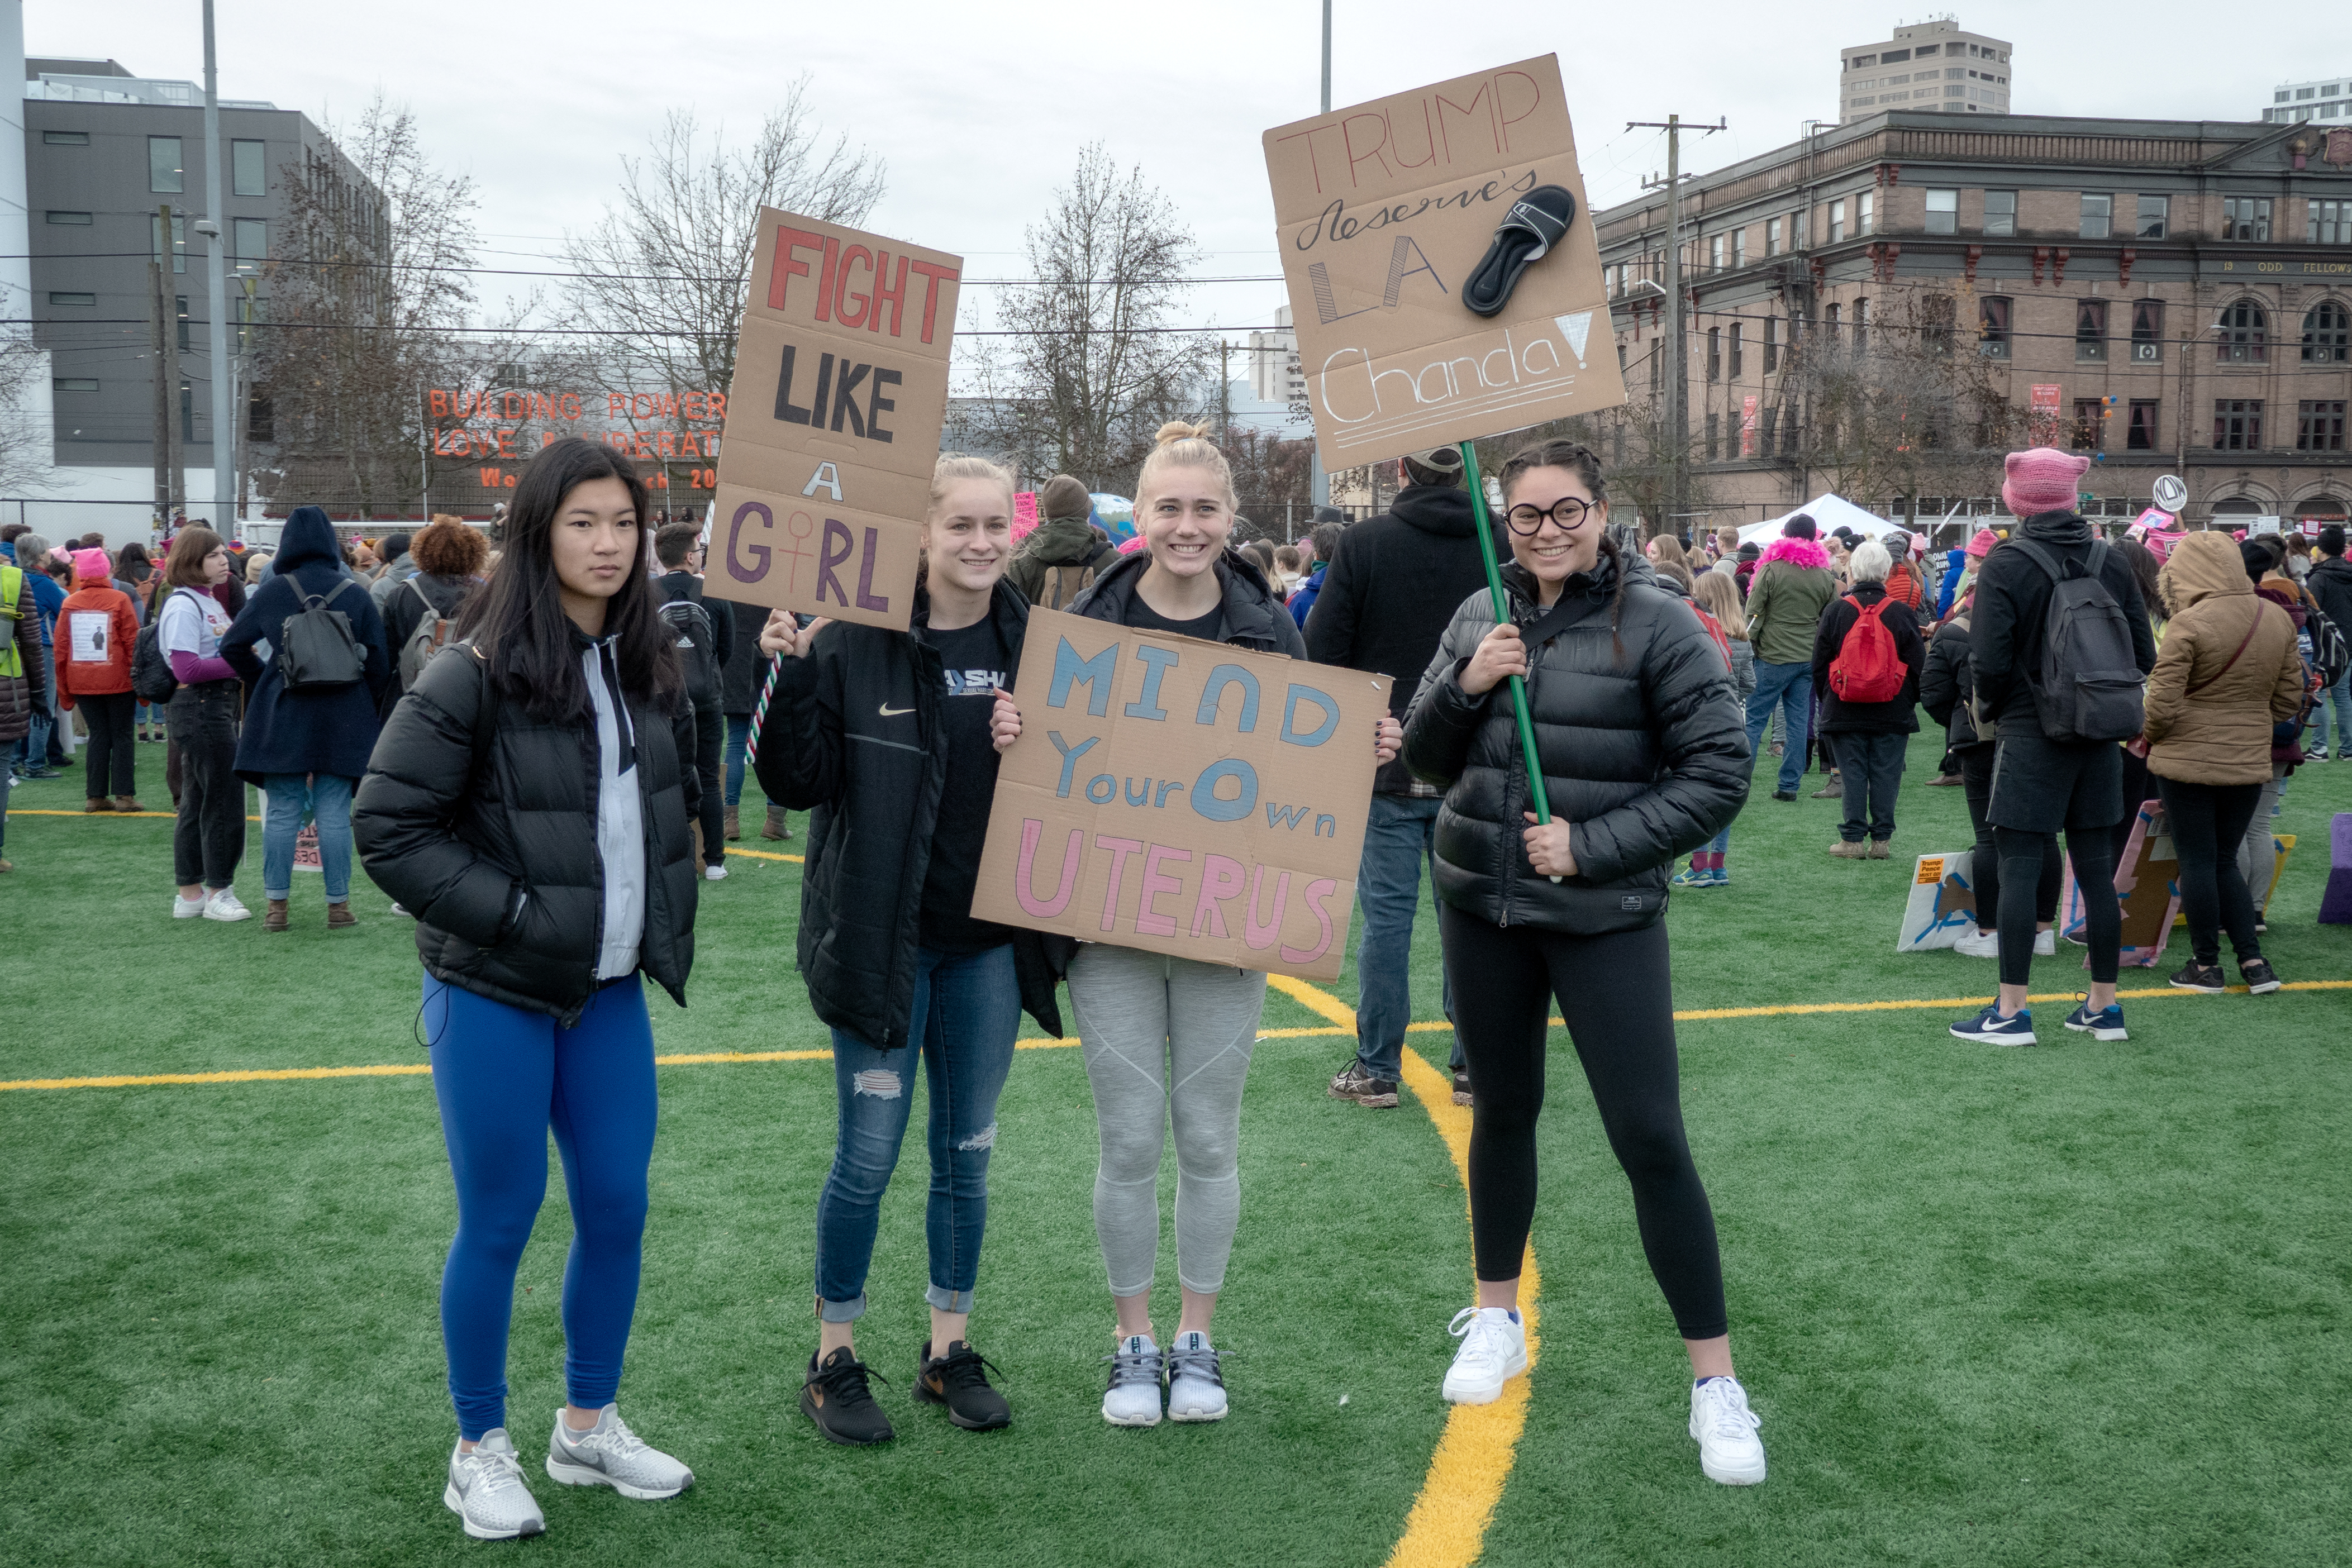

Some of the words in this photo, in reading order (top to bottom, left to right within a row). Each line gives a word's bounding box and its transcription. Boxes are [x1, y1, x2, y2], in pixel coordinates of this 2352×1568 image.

[1277, 71, 1540, 193] TRUMP
[767, 225, 959, 344] FIGHT
[1308, 235, 1448, 325] LA
[2258, 262, 2283, 272] ODD
[2303, 263, 2352, 273] FELLOWS
[429, 390, 582, 420] BUILDING
[609, 392, 726, 420] POWER
[774, 345, 902, 444] LIKE
[434, 427, 517, 458] LOVE
[583, 430, 725, 459] BERAT
[480, 467, 518, 488] Wo
[801, 461, 844, 502] A
[2156, 476, 2186, 503] NOW
[1046, 731, 1184, 808] Your
[1191, 758, 1336, 838] Own
[1015, 817, 1337, 964] UTERUS
